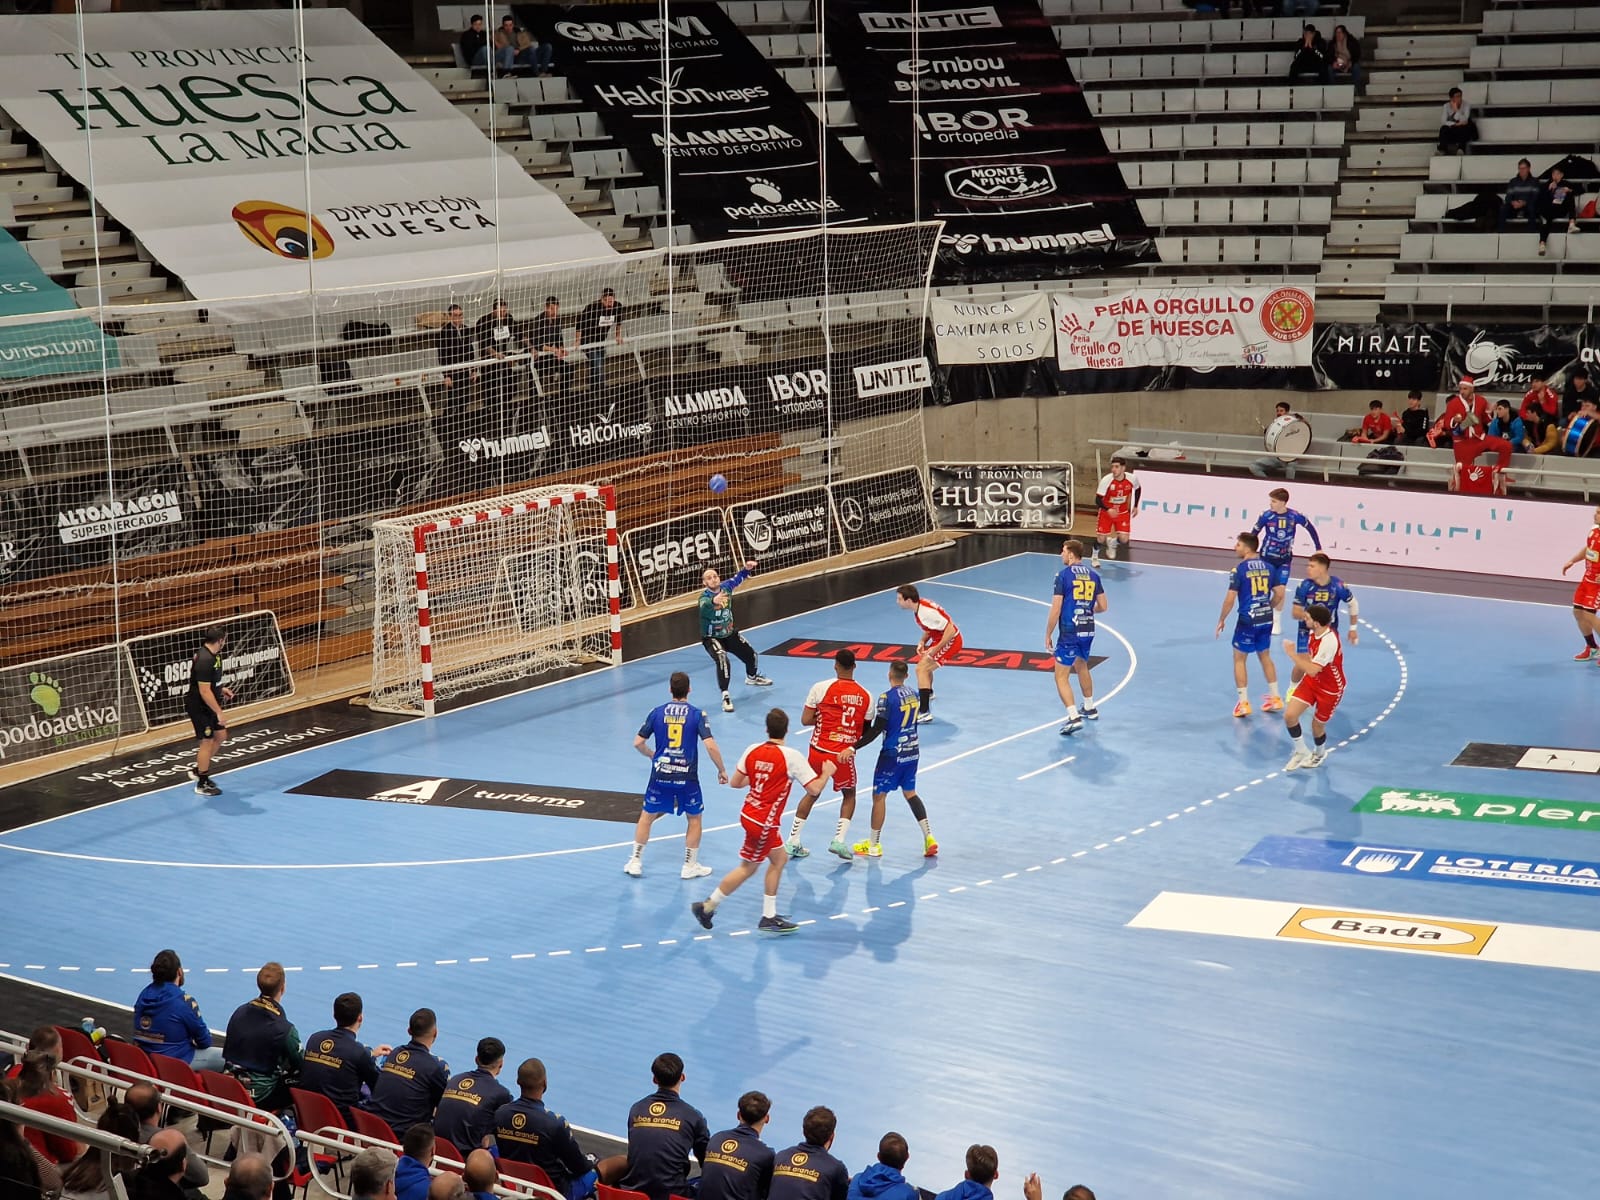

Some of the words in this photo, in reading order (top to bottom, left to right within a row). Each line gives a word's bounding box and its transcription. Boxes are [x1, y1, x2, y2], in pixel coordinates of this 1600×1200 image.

[869, 11, 994, 30] UNITIC
[573, 44, 637, 53] MARKETING
[897, 56, 1005, 75] embou
[652, 125, 793, 147] ALAMEDA
[938, 129, 1019, 144] ortopedia
[662, 147, 719, 158] CENTRO
[723, 138, 803, 156] DEPORTIVO
[971, 166, 1025, 178] MONTE
[981, 175, 1027, 186] PINOS
[326, 194, 484, 224] DIPUTACIÓN
[723, 198, 841, 220] podoactiva
[345, 213, 498, 241] HUESCA
[981, 223, 1116, 253] hummel
[0, 281, 38, 293] ES
[954, 303, 1014, 316] NUNCA
[1094, 295, 1148, 317] PEÑA
[1153, 297, 1255, 315] ORGULLO
[935, 317, 1048, 338] CAMINAREIS
[1117, 320, 1145, 337] DE
[1150, 318, 1235, 337] HUESCA
[977, 342, 1034, 359] SOLOS
[1337, 335, 1432, 353] MIRATE
[1086, 355, 1124, 369] Huesca
[767, 369, 828, 401] IBOR
[664, 385, 748, 417] ALAMEDA
[781, 395, 824, 414] ortopedia
[666, 416, 699, 429] CENTRO
[701, 406, 751, 424] DEPORTIVO
[484, 426, 551, 459] hummel
[58, 488, 178, 528] ALTOARAGÓN
[771, 508, 814, 528] Carpintería
[814, 505, 826, 517] de
[71, 511, 169, 540] SUPERMERCADOS
[776, 525, 811, 542] Aluminio
[638, 529, 721, 577] SERFEY
[1072, 580, 1096, 601] 28
[1251, 576, 1270, 597] 14
[1314, 591, 1329, 602] 23
[900, 701, 920, 728] 77
[667, 723, 683, 748] 9
[474, 789, 585, 806] turismo
[1331, 919, 1443, 941] Bada
[652, 1116, 681, 1126] aranda
[721, 1154, 748, 1168] aranda
[792, 1166, 821, 1178] aranda
